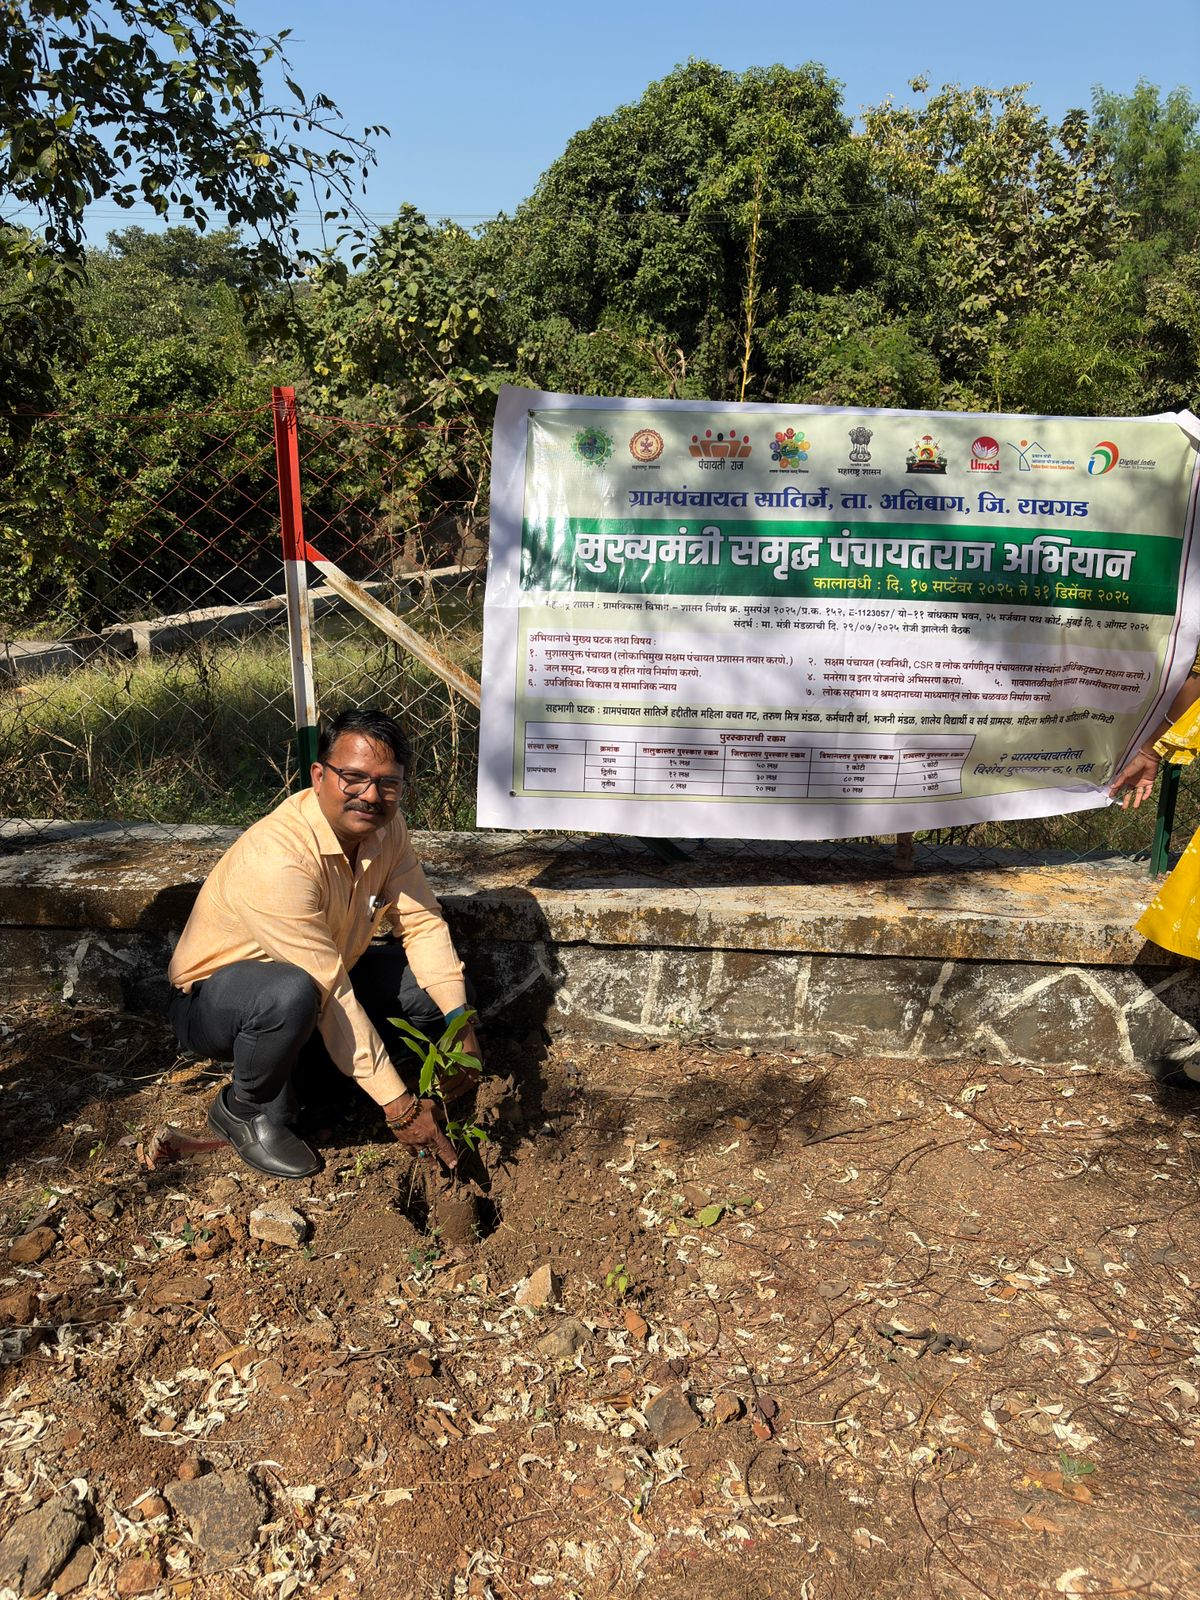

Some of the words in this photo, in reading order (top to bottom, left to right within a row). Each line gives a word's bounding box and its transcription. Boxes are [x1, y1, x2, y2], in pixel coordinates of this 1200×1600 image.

[698, 457, 726, 470] पंचायती
[730, 461, 744, 470] राज
[970, 459, 1000, 470] Umed
[1119, 458, 1139, 466] Digital
[838, 468, 860, 478] महाराष्ट्र
[862, 468, 881, 476] शासन
[629, 485, 749, 508] ग्रामपंचायत
[754, 486, 834, 511] सातिर्जे,
[841, 492, 872, 510] ता.
[880, 488, 970, 516] अलिबाग,
[978, 490, 1010, 514] जि.
[1018, 498, 1089, 517] रायगड
[575, 526, 723, 573] मुख्यमंत्री
[727, 534, 824, 581] समृद्ध
[827, 529, 996, 573] पंचायतराज
[1002, 535, 1137, 581] अभियान
[814, 570, 871, 591] कालावधी
[886, 574, 904, 593] दि.
[910, 578, 928, 594] १७
[932, 576, 973, 595] सप्टेंबर
[978, 580, 1013, 598] २०२५
[1018, 580, 1028, 598] ते
[1034, 584, 1049, 599] ३१
[1054, 582, 1093, 601] डिसेंबर
[1098, 589, 1130, 605] २०२५
[574, 601, 594, 609] शासन
[603, 600, 643, 612] ग्रामविकास
[645, 600, 669, 612] विभाग
[681, 604, 702, 613] शासन
[706, 602, 727, 613] निर्णय
[729, 606, 740, 614] क्र.
[826, 608, 845, 618] १५२,
[927, 609, 959, 621] बांधकाम
[961, 612, 982, 623] भवन,
[986, 614, 996, 622] २५
[999, 612, 1027, 624] मर्जबान
[1029, 616, 1042, 624] पथ
[1044, 614, 1064, 627] कोर्ट,
[1066, 617, 1083, 629] मुंबई
[1084, 617, 1094, 628] दि.
[1104, 619, 1128, 631] ऑगस्ट
[1130, 622, 1150, 633] २०२५
[733, 618, 753, 630] संदर्भ
[761, 620, 773, 629] मा.
[776, 618, 791, 630] मंत्री
[794, 618, 826, 631] मंडळाची
[828, 620, 839, 631] दि.
[843, 622, 900, 634] २९/०७/२०२५
[902, 622, 919, 633] रोजी
[921, 624, 949, 635] झालेली
[952, 624, 971, 635] बैठक
[529, 632, 571, 644] अभियानाचे
[572, 635, 591, 646] मुख्य
[593, 637, 612, 645] घटक
[614, 637, 630, 645] तथा
[631, 634, 652, 646] विषय
[529, 649, 538, 658] १.
[545, 650, 584, 661] सुशासयुक्त
[585, 648, 612, 660] पंचायत
[614, 650, 663, 663] (लोकाभिमुख
[665, 654, 685, 662] सक्षम
[687, 652, 715, 663] पंचायत
[716, 656, 745, 664] प्रशासन
[746, 656, 765, 664] तयार
[766, 654, 794, 666] करणे.)
[529, 664, 537, 673] ३.
[544, 664, 560, 673] जल
[562, 664, 585, 676] समृद्ध,
[587, 666, 609, 674] स्वच्छ
[619, 665, 635, 676] हरित
[637, 664, 652, 676] गांव
[654, 666, 678, 677] निर्माण
[679, 666, 702, 678] करणे.
[808, 657, 817, 666] २.
[824, 658, 845, 667] सक्षम
[846, 656, 875, 668] पंचायत
[876, 657, 912, 669] (स्वनिधी,
[914, 661, 933, 669] CSR
[942, 659, 961, 670] लोक
[962, 660, 995, 673] वर्गणीतून
[996, 661, 1033, 673] पंचायतराज
[1034, 663, 1061, 674] संस्थांना
[1105, 669, 1125, 678] सक्षम
[528, 679, 537, 688] ६.
[544, 676, 584, 689] उपजिविका
[586, 678, 612, 689] विकास
[621, 680, 657, 691] सामाजिक
[659, 683, 677, 691] न्याय
[824, 671, 847, 682] मनरेगा
[849, 674, 856, 682] व
[857, 674, 872, 683] इतर
[873, 672, 905, 684] योजनांचे
[908, 673, 941, 685] अभिसरण
[942, 675, 964, 686] करणे.
[995, 679, 1003, 687] ५.
[1079, 677, 1120, 691] सक्षमीकरण
[1121, 684, 1141, 693] करणे.
[806, 688, 815, 696] ७.
[822, 686, 841, 697] लोक
[843, 689, 871, 699] सहभाग
[880, 690, 922, 700] श्रमदानाच्या
[924, 691, 960, 702] माध्यमातून
[962, 690, 980, 700] लोक
[982, 693, 1008, 701] चळवळ
[1010, 691, 1031, 702] निर्माण
[1033, 692, 1052, 702] करणे.
[546, 702, 575, 713] सहभागी
[577, 706, 595, 714] घटक
[603, 704, 641, 716] ग्रामपंचायत
[644, 706, 669, 717] सातिर्जे
[670, 706, 698, 719] हद्दीतील
[701, 708, 723, 720] महिला
[746, 712, 760, 721] गट,
[763, 712, 782, 721] तरुण
[785, 710, 799, 721] मित्र
[802, 710, 823, 723] मंडळ,
[826, 712, 854, 723] कर्मचारी
[857, 712, 870, 724] वर्ग,
[874, 713, 895, 724] भजनी
[898, 713, 918, 726] मंडळ,
[920, 714, 941, 725] शालेय
[944, 714, 968, 725] विद्यार्थी
[977, 715, 989, 725] सर्व
[990, 718, 1014, 726] ग्रामस्थ,
[1017, 715, 1038, 726] महिला
[1040, 714, 1059, 725] भगिनी
[1091, 713, 1115, 724] कमिटी
[720, 732, 764, 744] पुरस्काराची
[1011, 748, 1084, 762] ग्रामपंचायतीला
[974, 763, 1006, 775] विशेष
[1004, 766, 1052, 777] पुरस्कार
[1076, 764, 1096, 773] लक्ष
